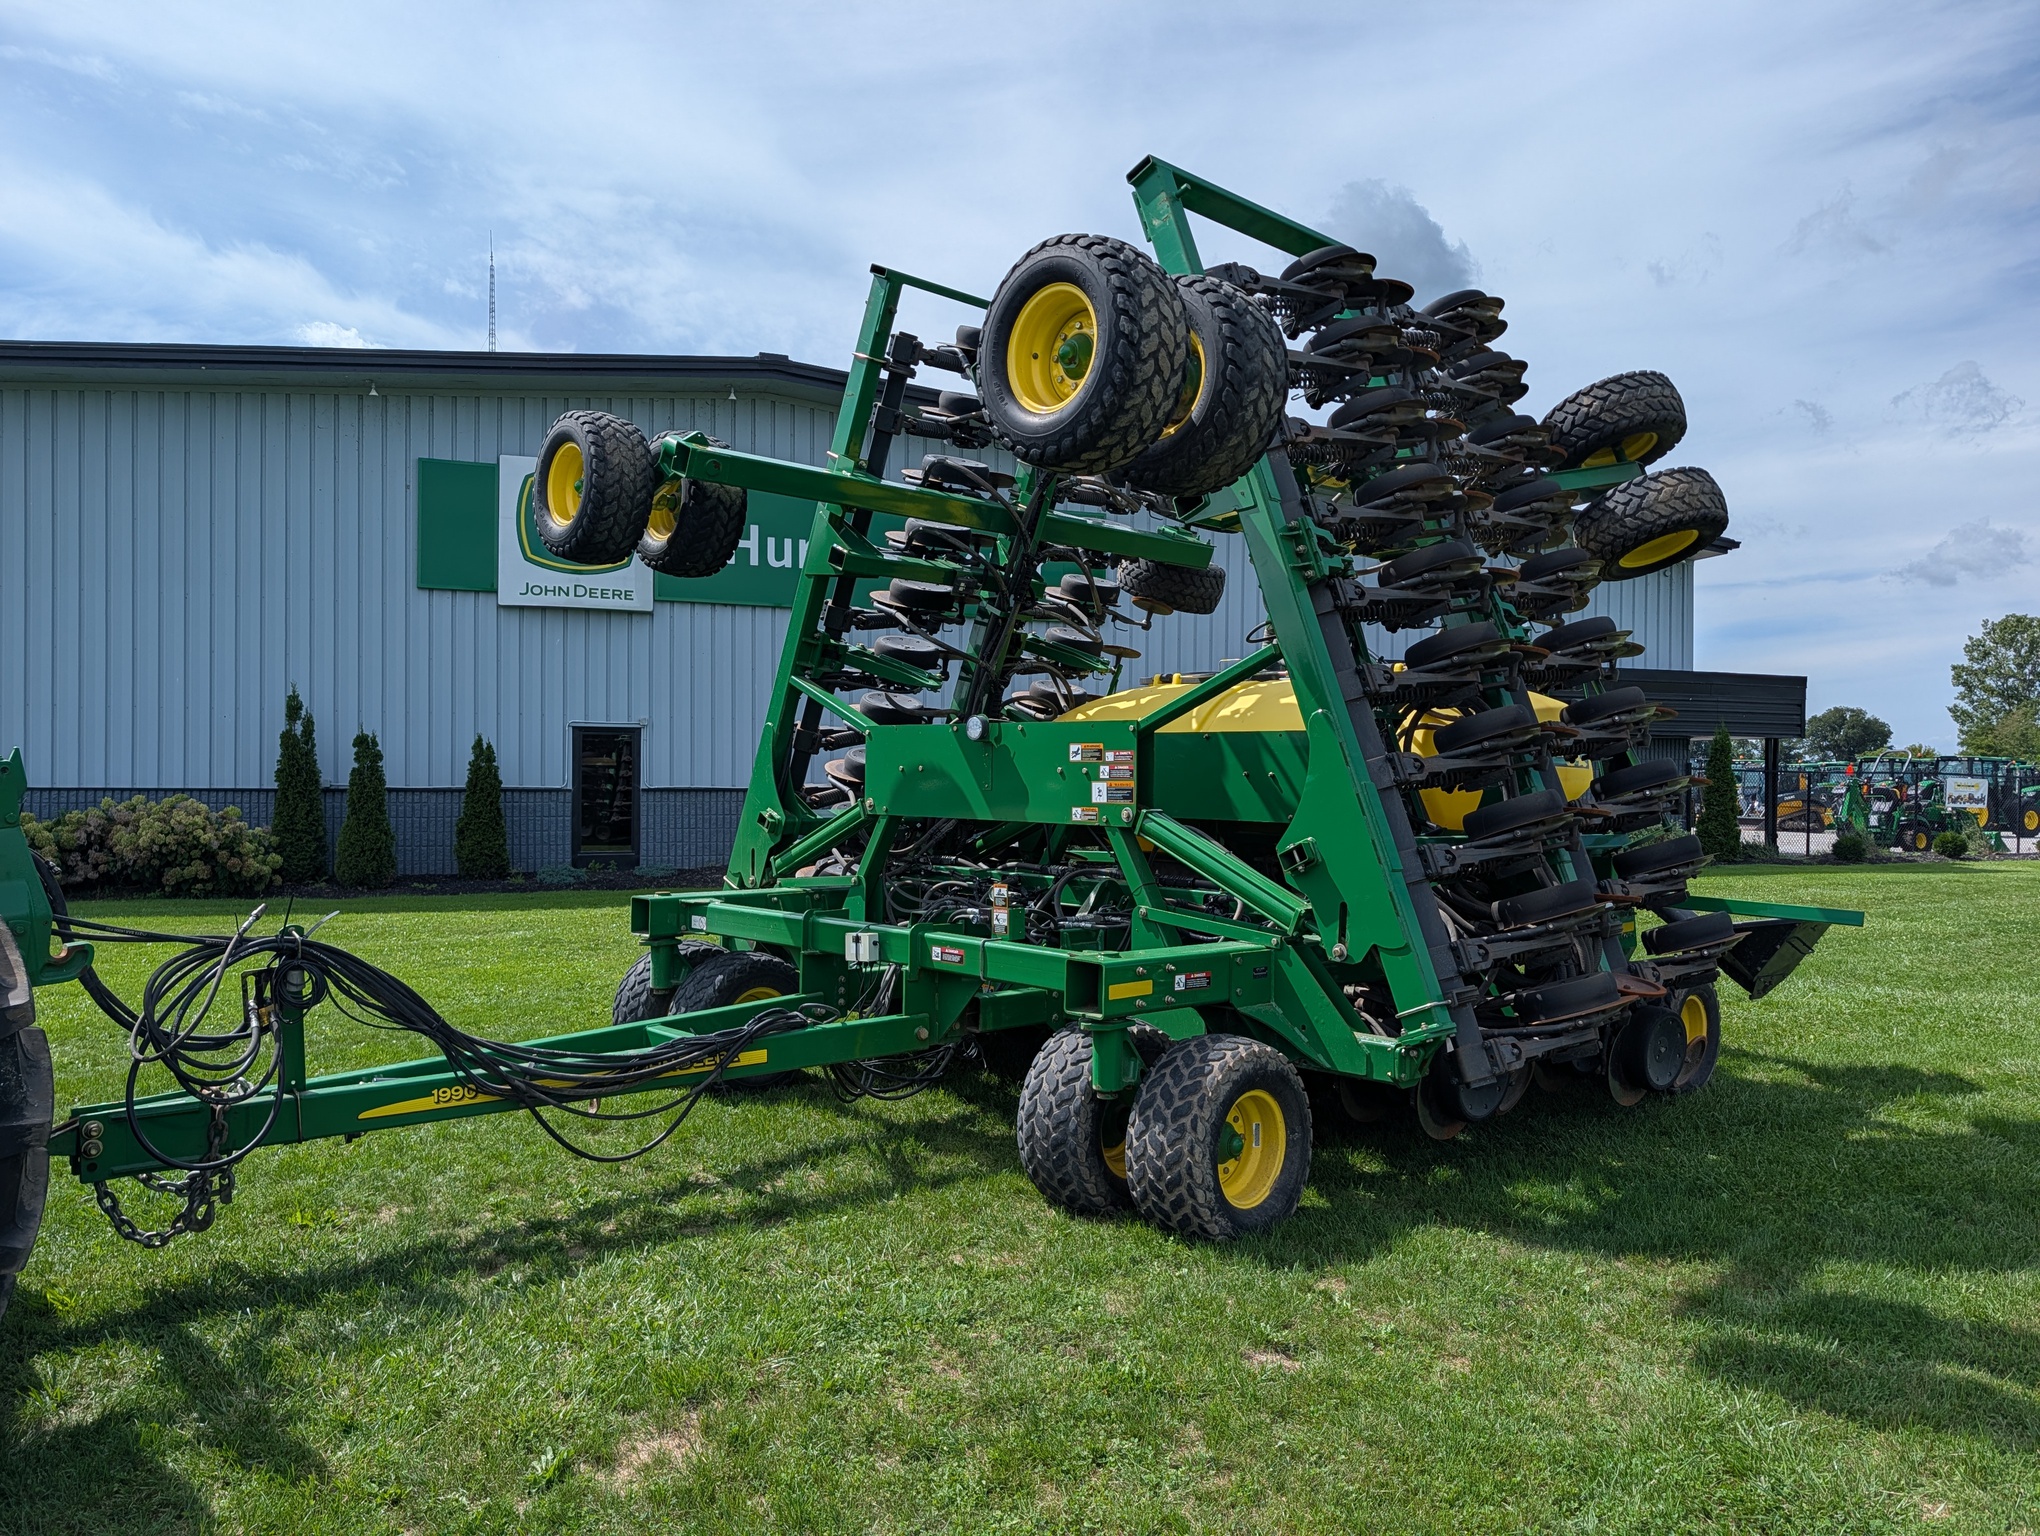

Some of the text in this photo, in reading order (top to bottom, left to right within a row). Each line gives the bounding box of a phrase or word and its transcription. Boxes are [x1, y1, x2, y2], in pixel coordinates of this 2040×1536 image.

[519, 582, 634, 601] JOHN DEERE
[432, 1083, 477, 1103] 1990
